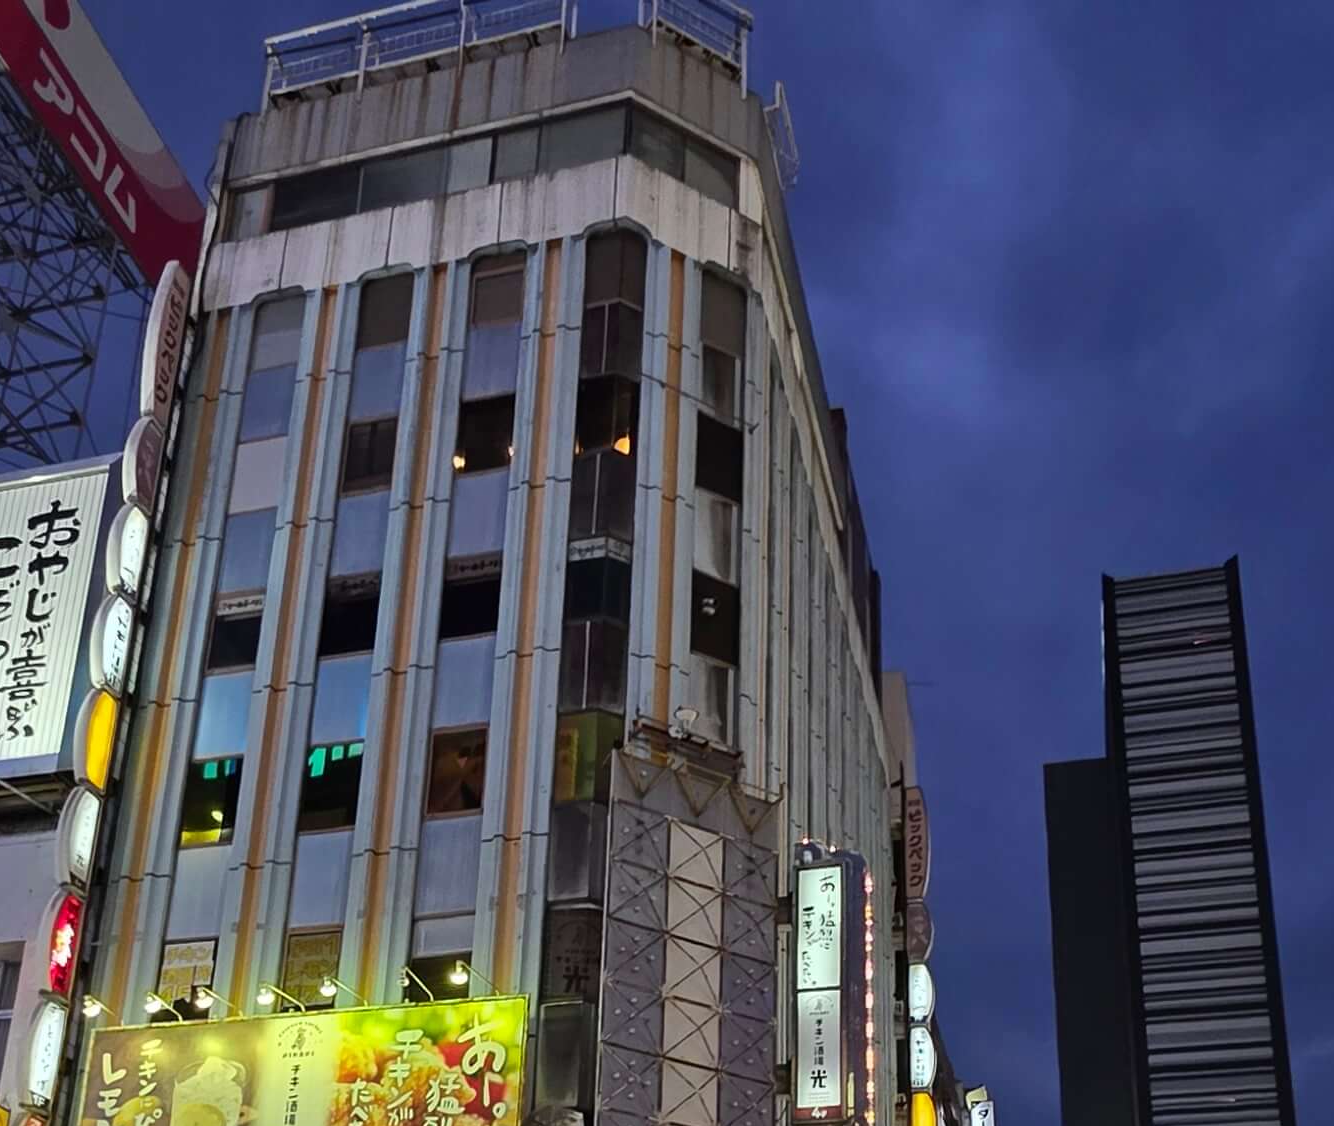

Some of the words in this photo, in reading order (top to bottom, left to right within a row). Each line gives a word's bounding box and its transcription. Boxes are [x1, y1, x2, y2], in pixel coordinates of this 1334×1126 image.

[33, 49, 137, 234] アコム
[387, 1030, 425, 1126] チキンが
[810, 1070, 828, 1090] 光
